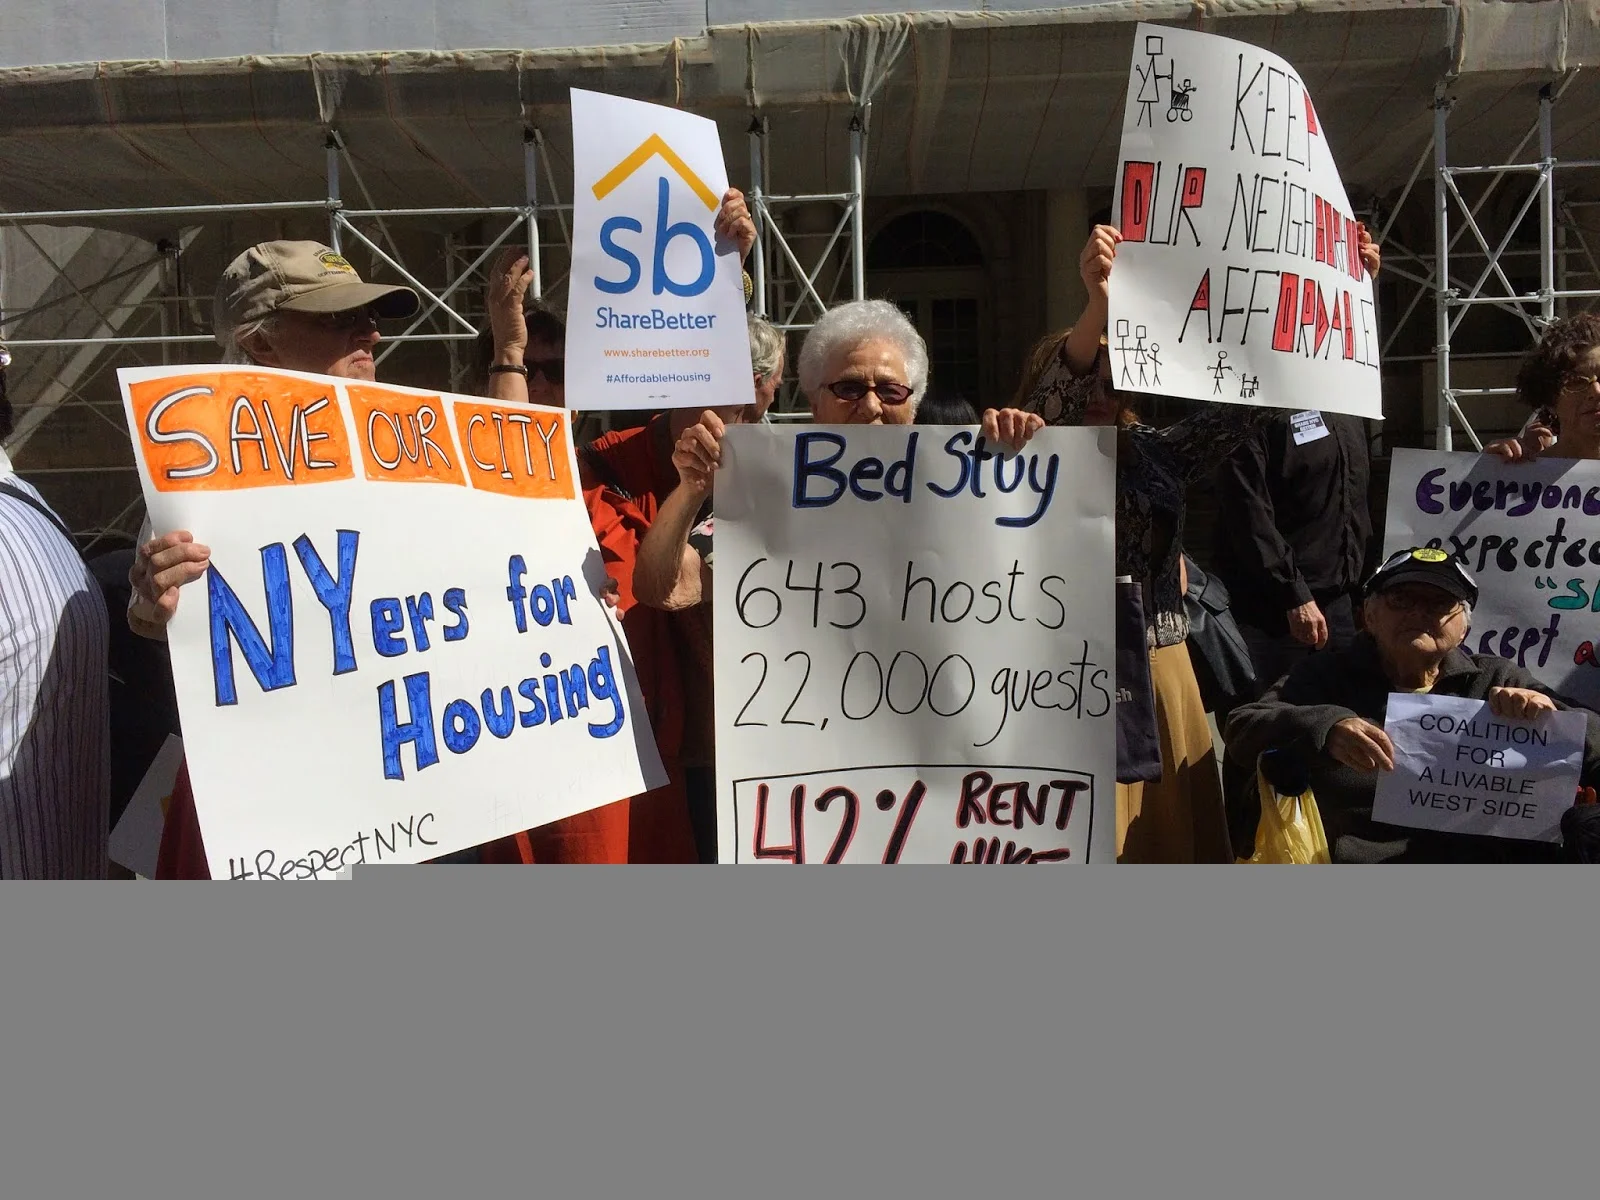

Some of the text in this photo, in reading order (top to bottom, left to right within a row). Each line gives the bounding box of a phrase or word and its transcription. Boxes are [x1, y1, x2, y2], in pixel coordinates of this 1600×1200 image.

[1230, 53, 1318, 172] KEEP
[593, 176, 716, 298] sb
[1120, 160, 1207, 247] OUR
[595, 306, 717, 330] ShareBetter
[603, 347, 710, 358] www.sharebetter.org
[1178, 266, 1378, 370] AFFORDABLE
[605, 372, 711, 384] #AffordableHousing
[145, 386, 559, 481] SAVE OUR CITY
[791, 430, 1060, 528] Bed Stuy
[206, 528, 577, 707] NYers for
[734, 557, 1066, 630] 643 hosts
[376, 645, 626, 782] Housing
[733, 639, 1110, 747] 22,000 guests
[1419, 713, 1548, 747] COALITION
[1418, 766, 1536, 796] A LIVABLE
[1455, 745, 1506, 768] FOR
[955, 770, 1090, 831] RENT
[1409, 789, 1538, 819] WEST SIDE
